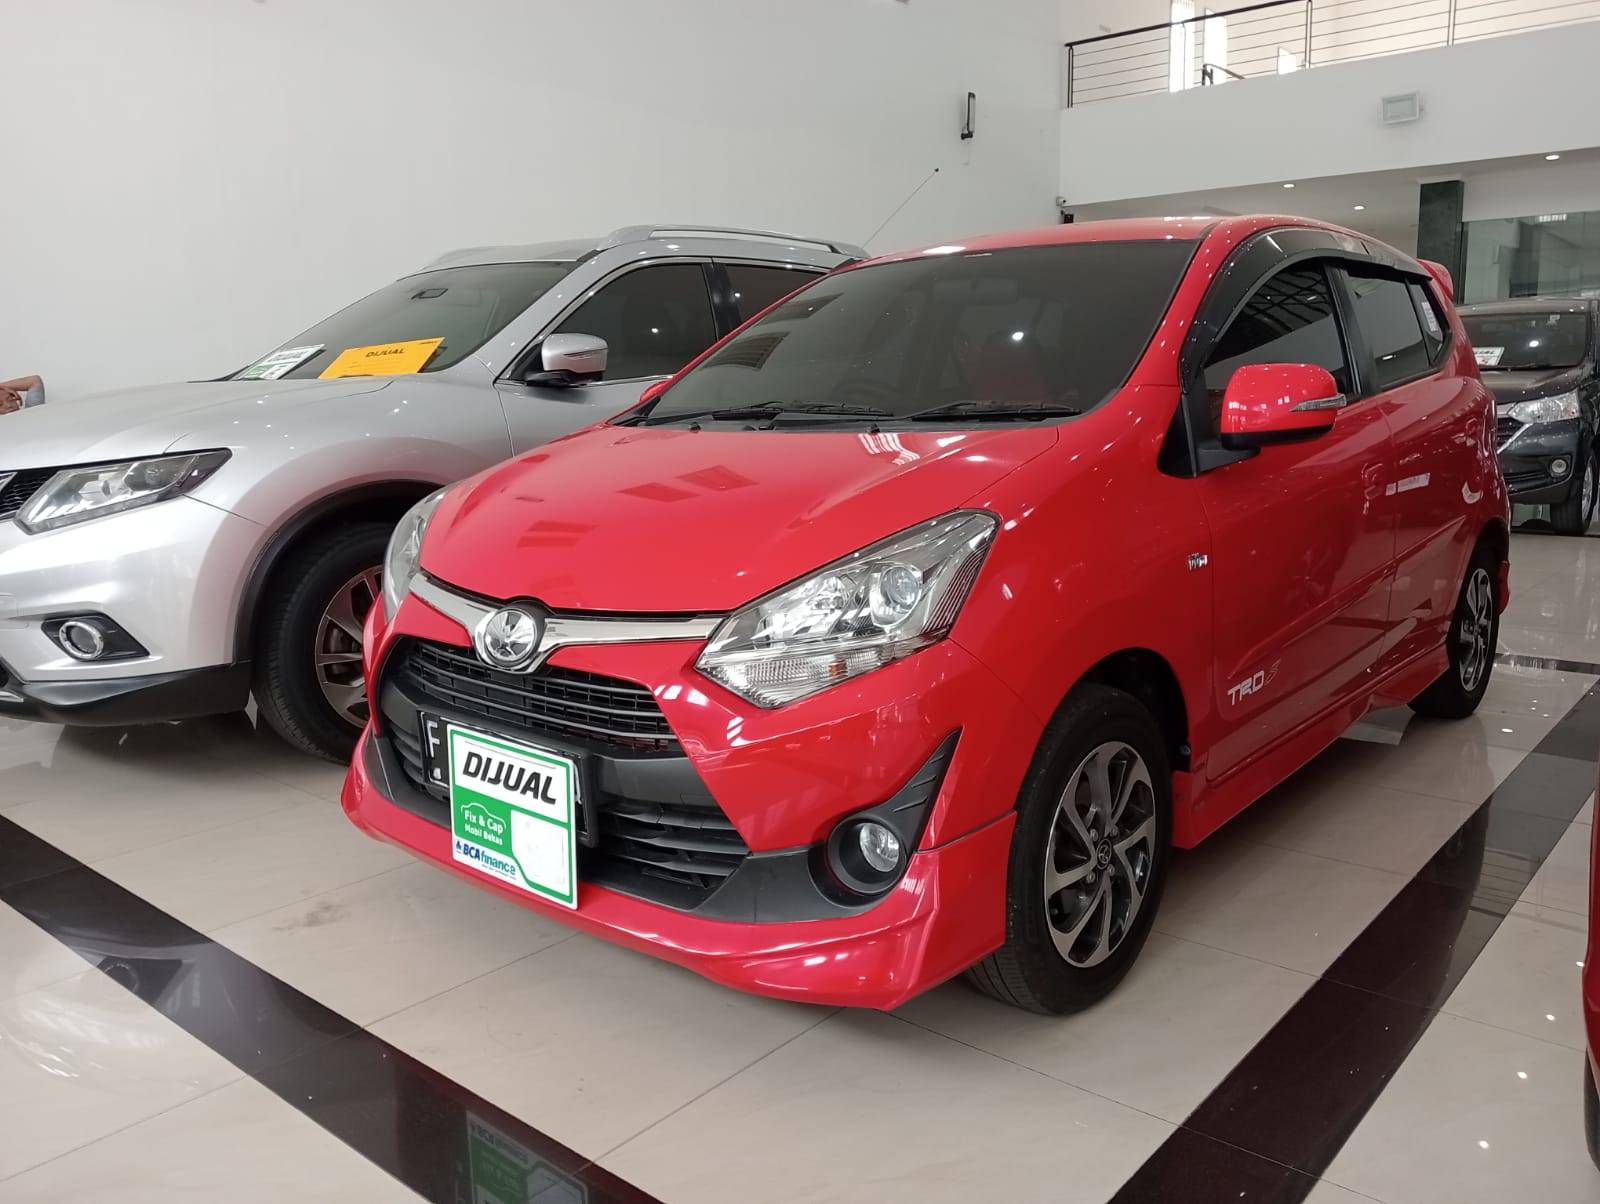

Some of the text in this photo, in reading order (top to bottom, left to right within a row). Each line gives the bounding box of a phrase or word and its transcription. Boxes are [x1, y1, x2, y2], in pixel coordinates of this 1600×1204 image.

[1227, 670, 1264, 705] TRD
[427, 720, 440, 758] F
[462, 751, 556, 805] DIJUAL
[465, 810, 504, 836] Fix & Cap
[465, 823, 503, 846] Mobil Bekas
